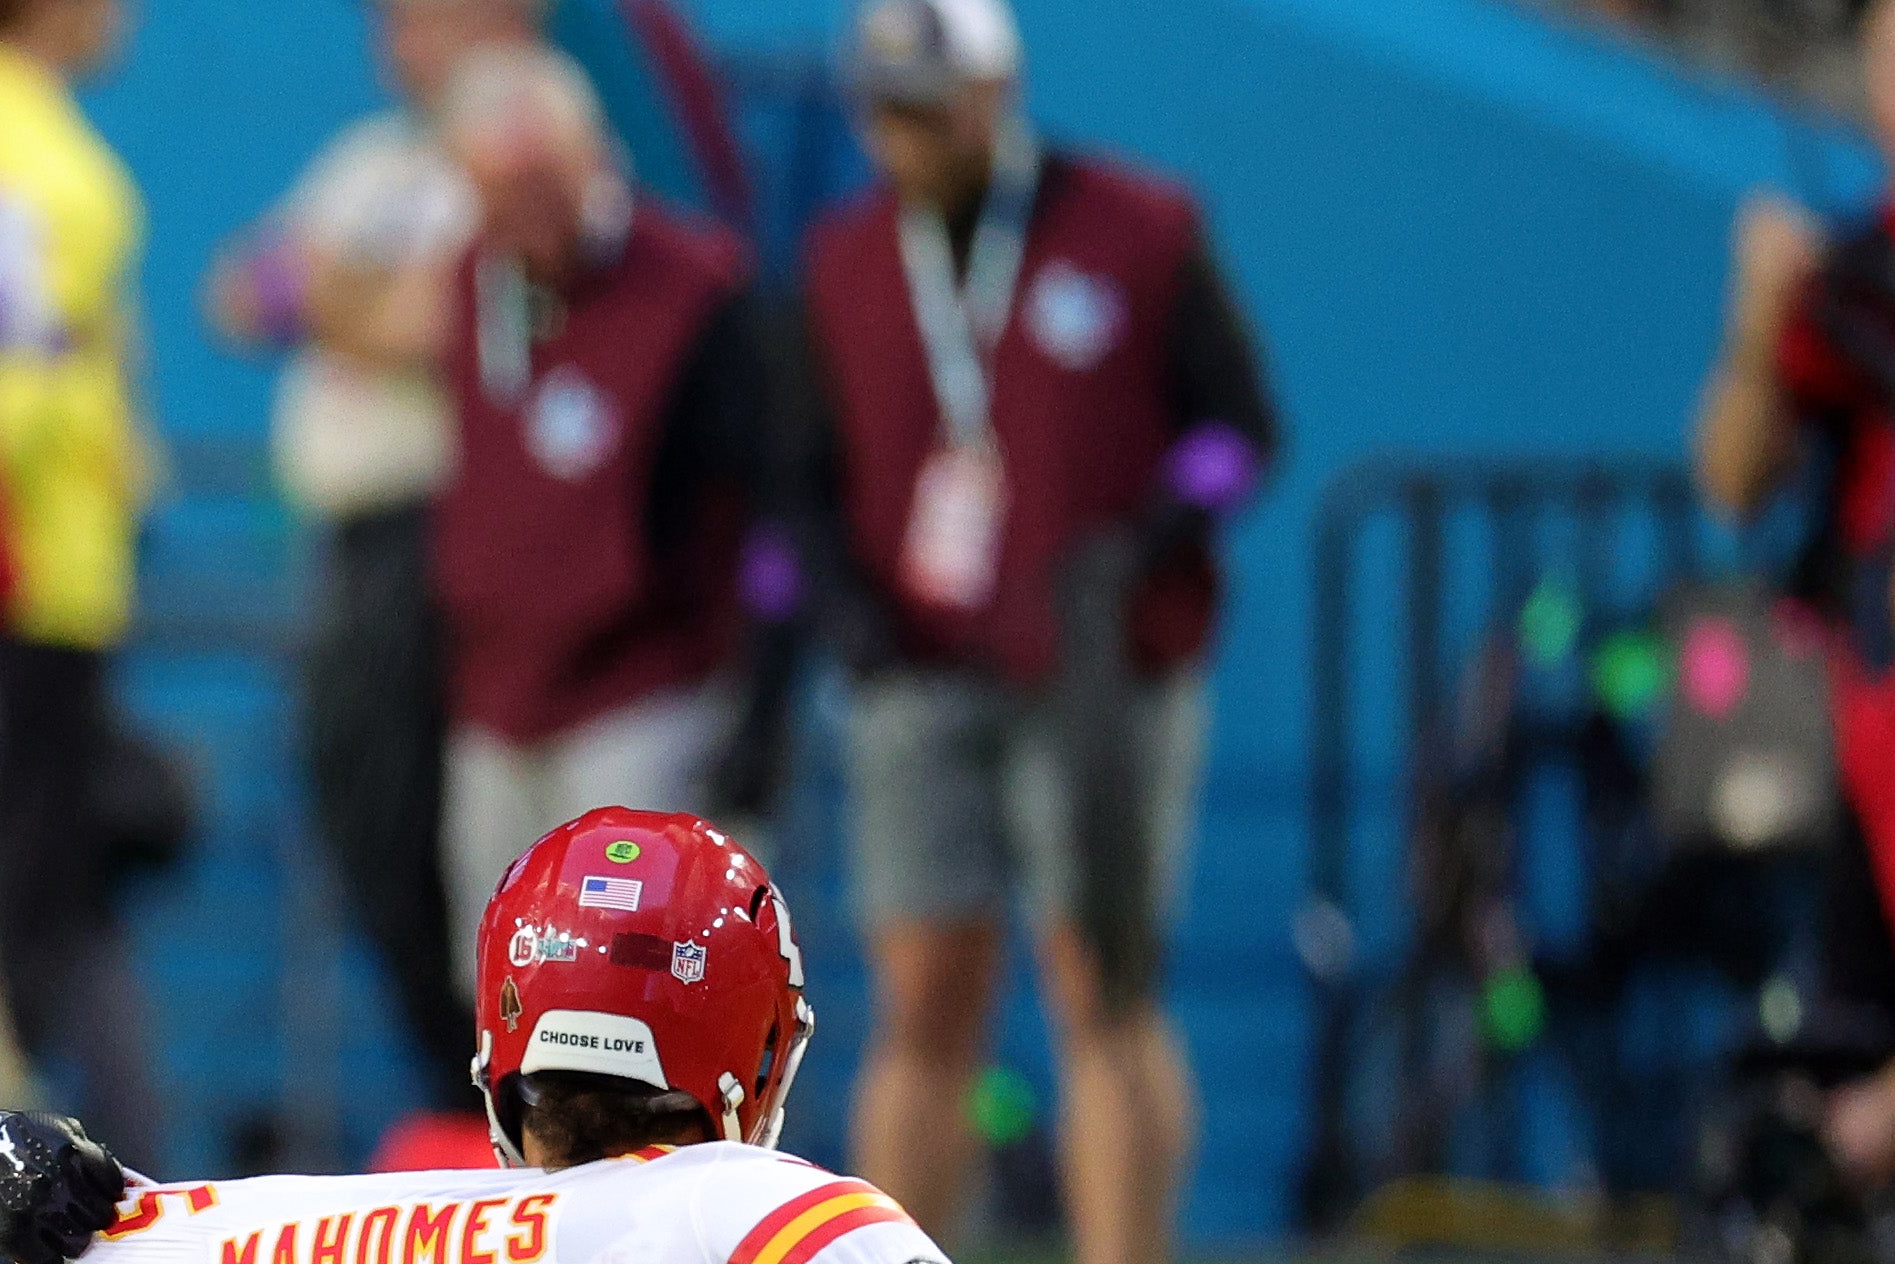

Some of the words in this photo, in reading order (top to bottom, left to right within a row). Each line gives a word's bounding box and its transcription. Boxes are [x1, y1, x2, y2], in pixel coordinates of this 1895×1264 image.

[677, 958, 701, 976] NFL
[540, 1030, 599, 1049] CHOOSE
[604, 1038, 644, 1053] LOVE
